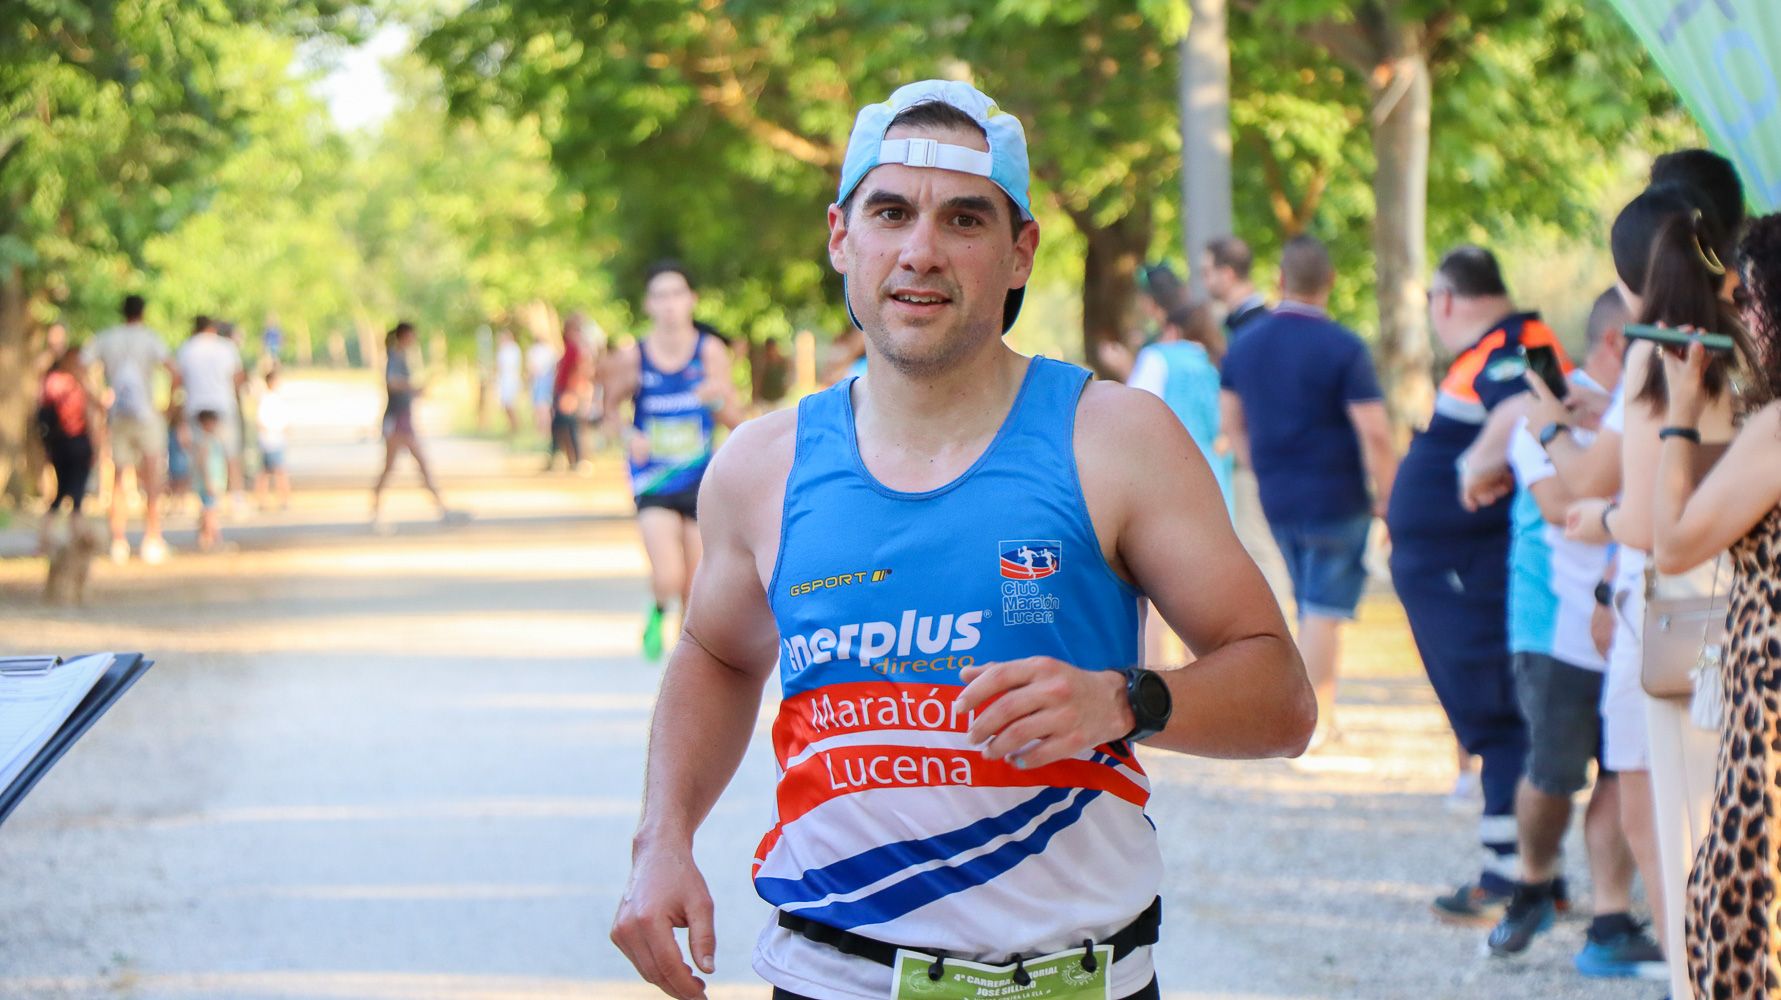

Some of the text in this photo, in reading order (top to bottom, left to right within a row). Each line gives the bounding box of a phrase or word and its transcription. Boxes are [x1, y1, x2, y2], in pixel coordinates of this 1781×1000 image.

[789, 571, 867, 597] GSPORT
[1001, 581, 1040, 597] Club
[872, 655, 975, 675] directo
[826, 753, 972, 790] Lucena
[966, 975, 1011, 988] CARRERA
